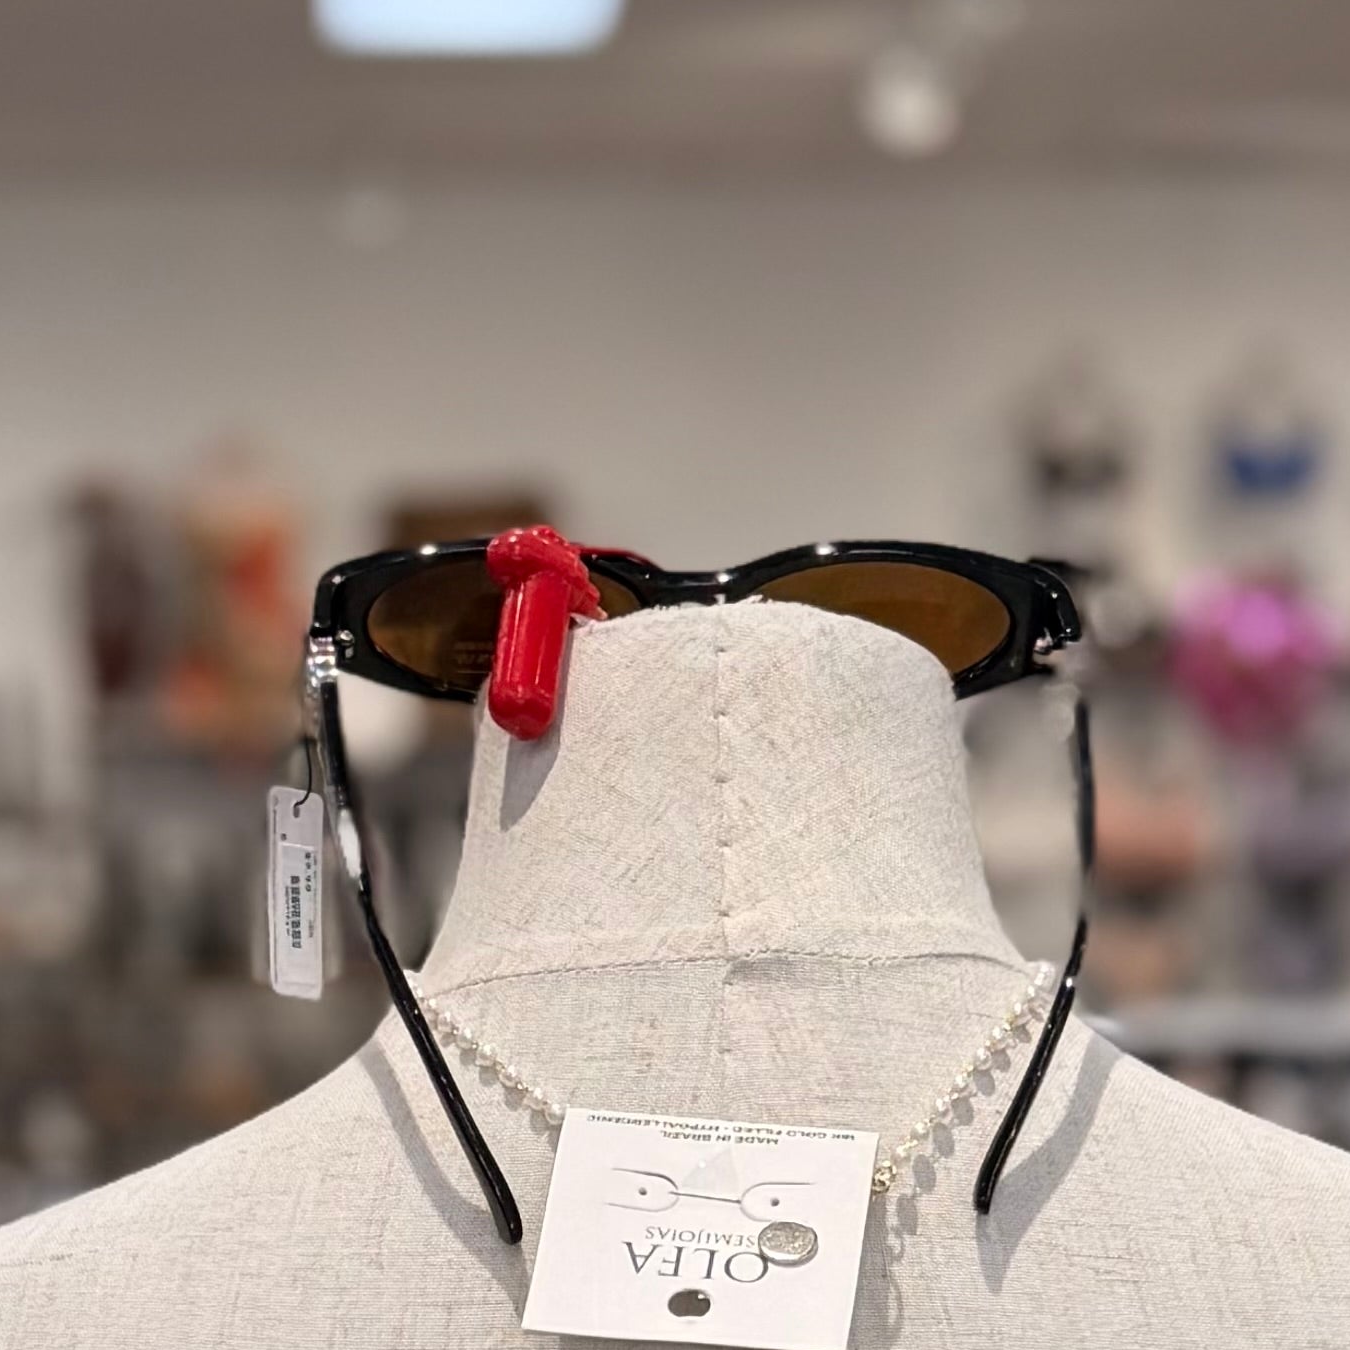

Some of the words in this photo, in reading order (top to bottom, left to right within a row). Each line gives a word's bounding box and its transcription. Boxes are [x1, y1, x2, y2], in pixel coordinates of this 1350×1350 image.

[660, 1130, 712, 1142] BRAZIL
[715, 1134, 732, 1143] IN
[785, 1129, 828, 1139] GOLD
[734, 1135, 779, 1145] MADE
[644, 1225, 756, 1248] SEMIJOIAS
[621, 1241, 769, 1284] OLFA
